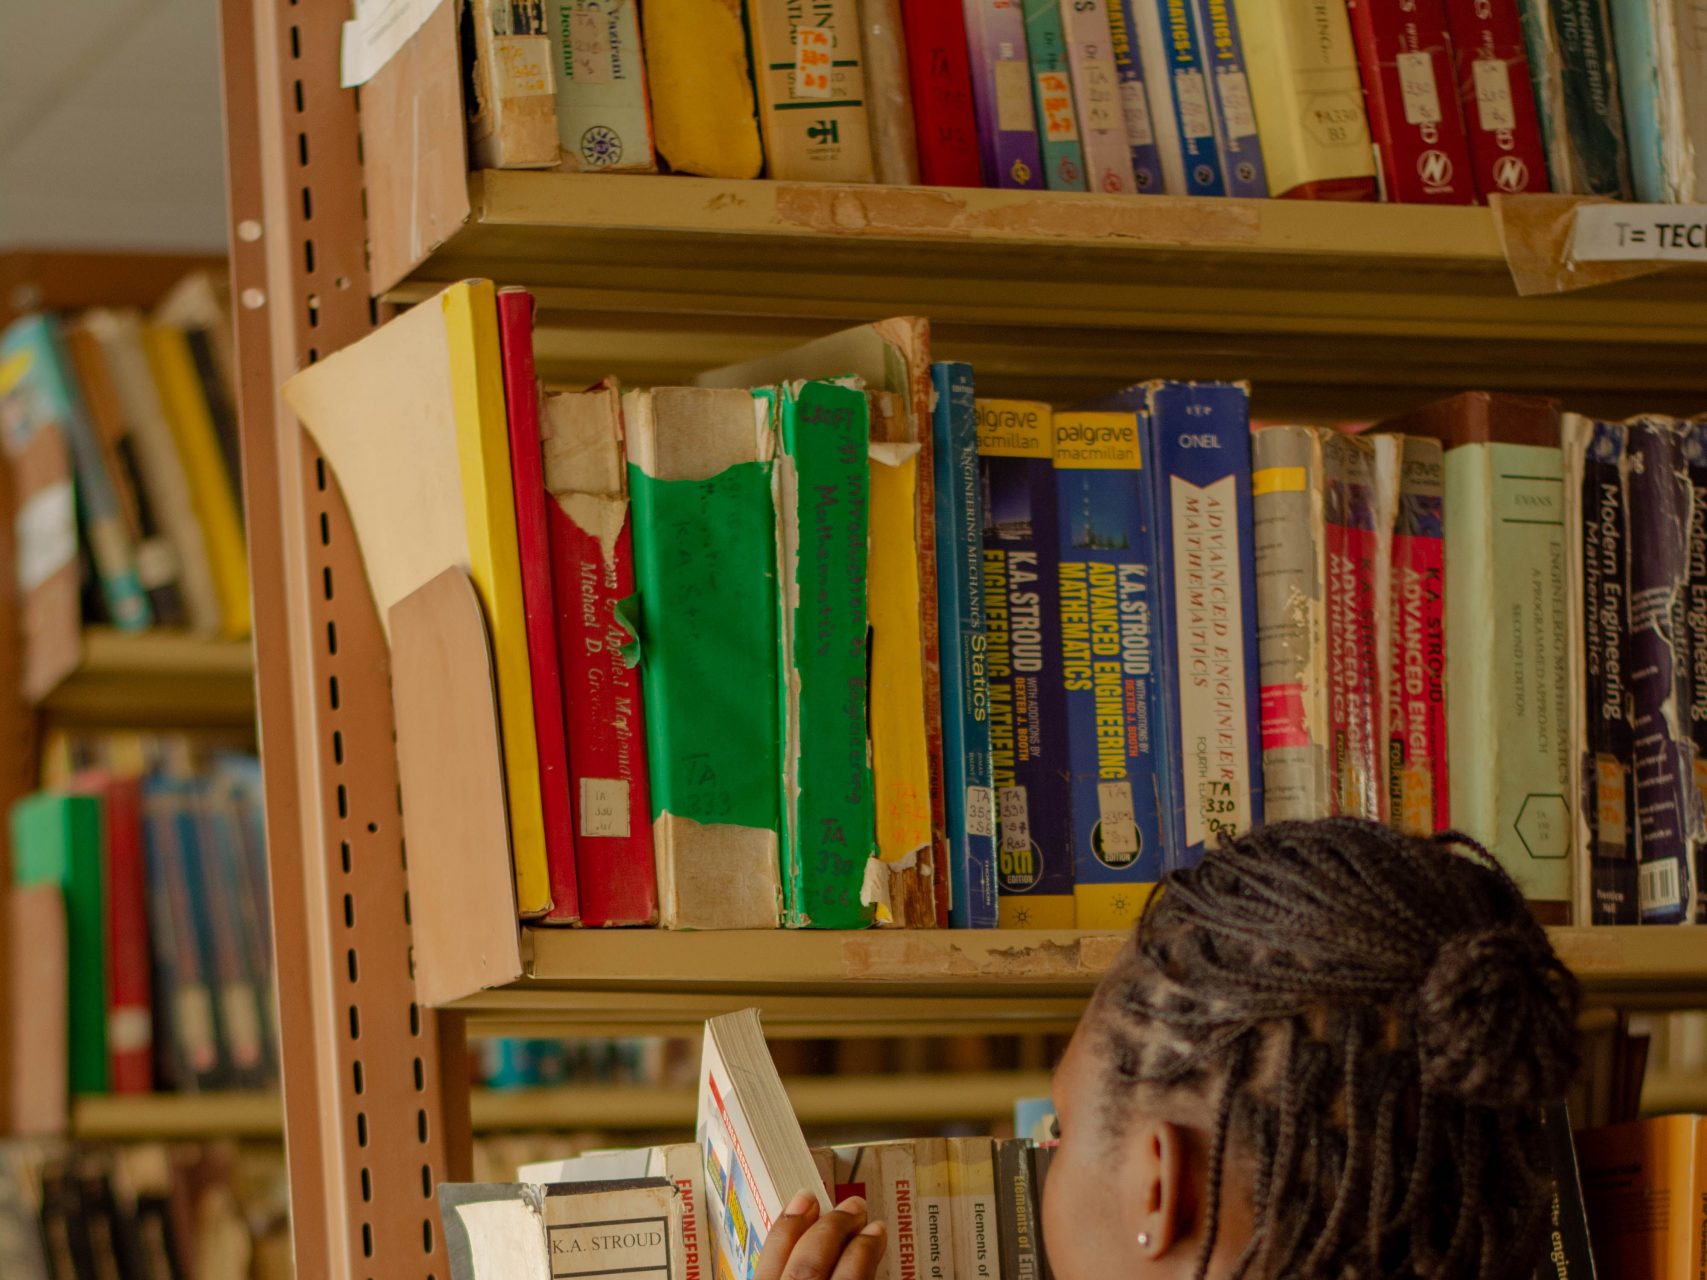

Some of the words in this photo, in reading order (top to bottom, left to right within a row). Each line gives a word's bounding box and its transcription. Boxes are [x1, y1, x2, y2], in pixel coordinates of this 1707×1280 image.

[1614, 223, 1646, 247] T=
[975, 405, 1039, 433] algrave
[976, 433, 1039, 449] acmillan
[1056, 423, 1134, 446] palgrave
[1055, 448, 1135, 462] macmillan
[961, 447, 978, 543] ENGINEERING
[1207, 495, 1230, 618] ADVANCED
[1601, 483, 1621, 575] Modern
[1689, 486, 1707, 577] Modern
[581, 561, 600, 627] Michael
[966, 545, 982, 629] MECHANICS
[983, 549, 1011, 678] ENGINEERING
[1089, 561, 1121, 656] ADVANCED
[1185, 496, 1209, 691] MATHEMATICS
[1585, 520, 1602, 675] Mathematics
[585, 638, 603, 657] D.
[1058, 562, 1094, 691] MATHEMATICS
[1329, 553, 1345, 723] MATHEMATICS
[1403, 566, 1423, 695] ADVANCED
[1512, 603, 1525, 659] SECOND
[1600, 581, 1624, 720] Engineering
[1688, 583, 1707, 721] Engineering
[971, 633, 988, 723] Statics
[1026, 677, 1038, 699] WITH
[1425, 615, 1443, 704] STROUD
[1015, 677, 1027, 714] DEXTER
[1125, 678, 1137, 714] DEXTER
[1135, 679, 1146, 700] WITH
[1213, 644, 1236, 781] ENGINEER
[1514, 662, 1526, 718] EDITION
[1017, 728, 1030, 761] BOOTH
[1028, 700, 1040, 746] ADDITIONS
[1093, 661, 1127, 779] ENGINEERING
[1128, 726, 1139, 757] BOOTH
[1196, 736, 1209, 779] FOURTH
[1208, 781, 1232, 797] TA
[1007, 875, 1034, 884] EDITION
[973, 1202, 988, 1260] Elements
[1013, 1174, 1029, 1233] Elements
[552, 1239, 587, 1255] K.A.
[591, 1231, 663, 1251] STROUD
[927, 1203, 942, 1262] Elements
[1018, 1235, 1031, 1249] of
[930, 1264, 943, 1279] of
[977, 1263, 990, 1278] of
